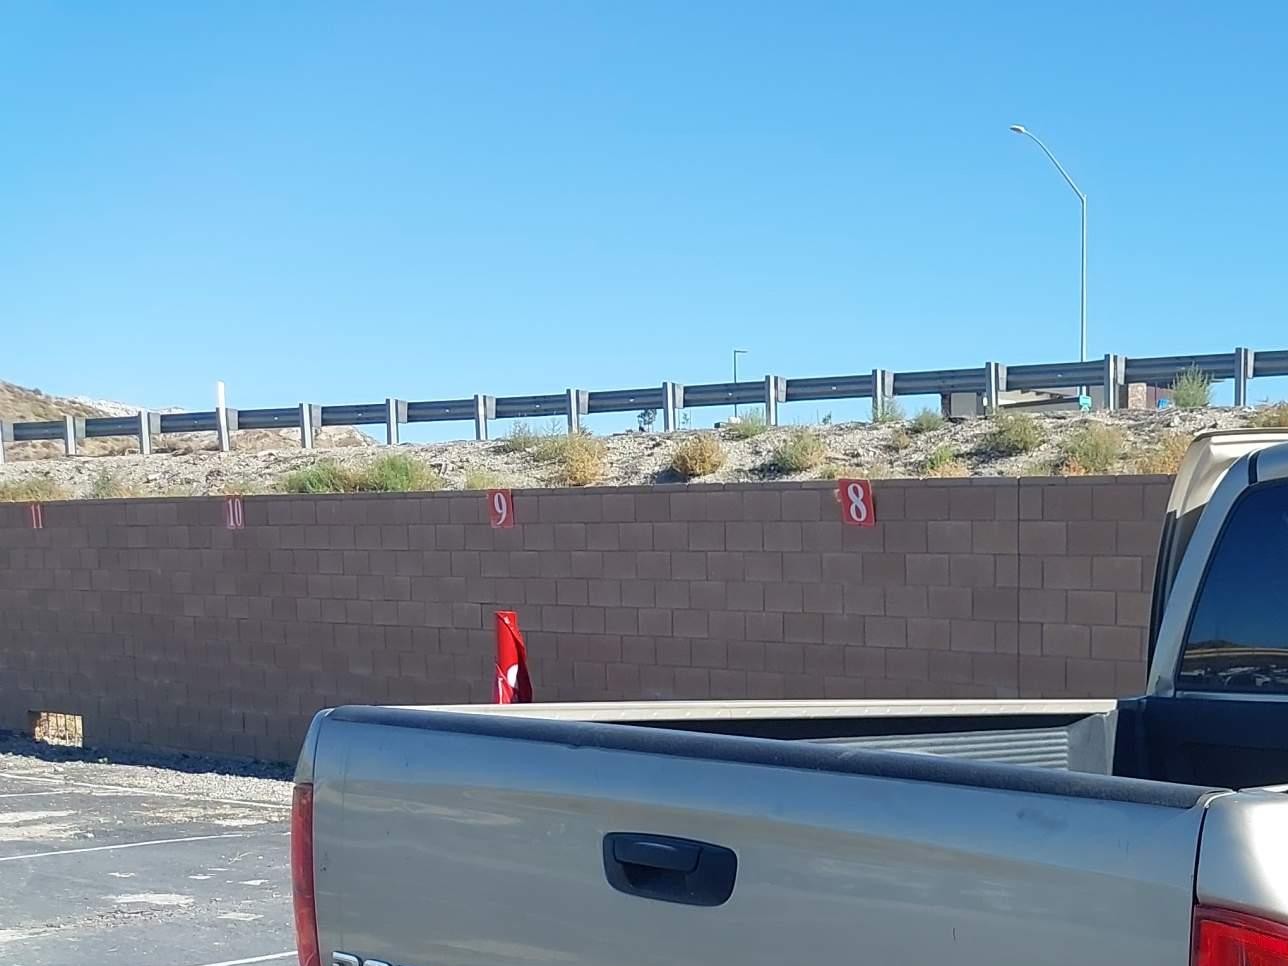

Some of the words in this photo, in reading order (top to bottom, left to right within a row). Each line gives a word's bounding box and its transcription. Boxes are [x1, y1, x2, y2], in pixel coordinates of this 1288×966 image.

[31, 503, 43, 528] 11
[228, 498, 242, 527] 10
[494, 492, 507, 525] 9
[848, 483, 867, 522] 8
